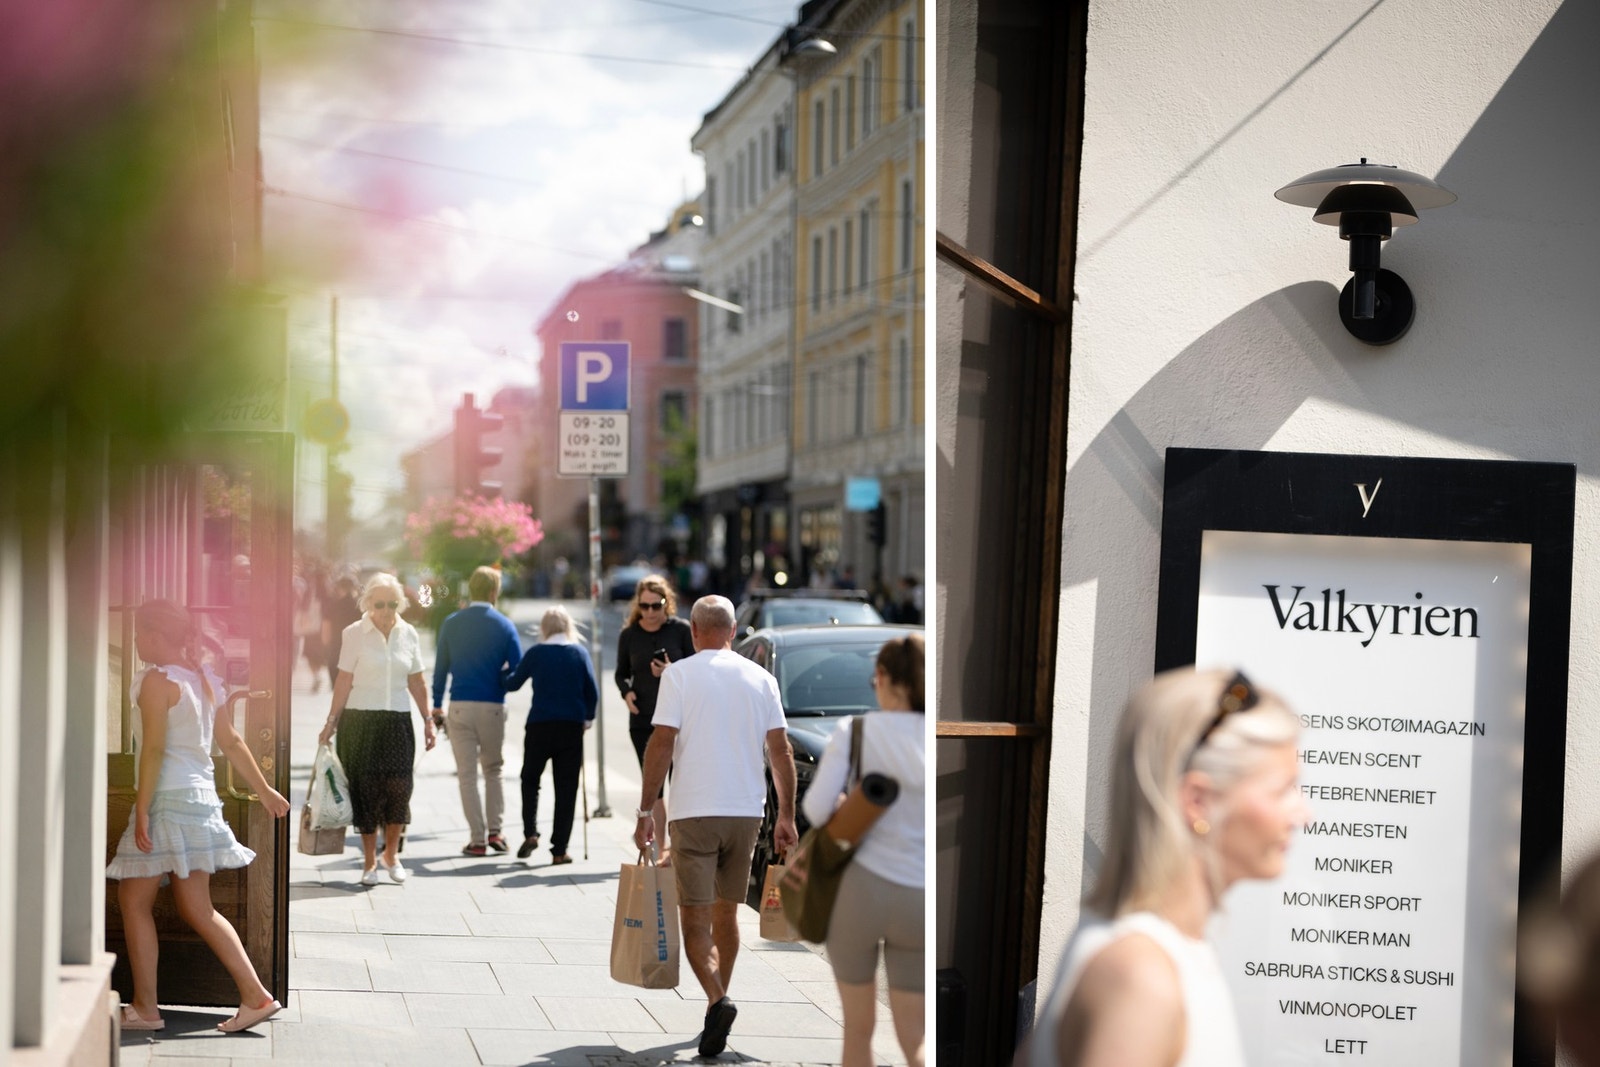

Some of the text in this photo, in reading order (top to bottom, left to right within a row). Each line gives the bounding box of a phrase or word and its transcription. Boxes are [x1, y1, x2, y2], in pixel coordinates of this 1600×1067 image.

[575, 351, 613, 404] P
[1262, 585, 1481, 648] Valkyrien
[1346, 716, 1486, 736] SKOTØIMAGAZIN
[1296, 749, 1422, 769] HEAVEN SCENT
[1293, 785, 1437, 805] FFEBRENNERIET
[1303, 821, 1408, 839] MAANESTEN
[1314, 857, 1393, 874] MONIKER
[1283, 891, 1422, 912] MONIKER SPORT
[1291, 928, 1411, 948] MONIKER MAN
[1244, 961, 1454, 987] SABRURA STICKS & SUSHI
[1279, 999, 1418, 1021] VINMONOPOLET
[1325, 1038, 1368, 1055] LETT
